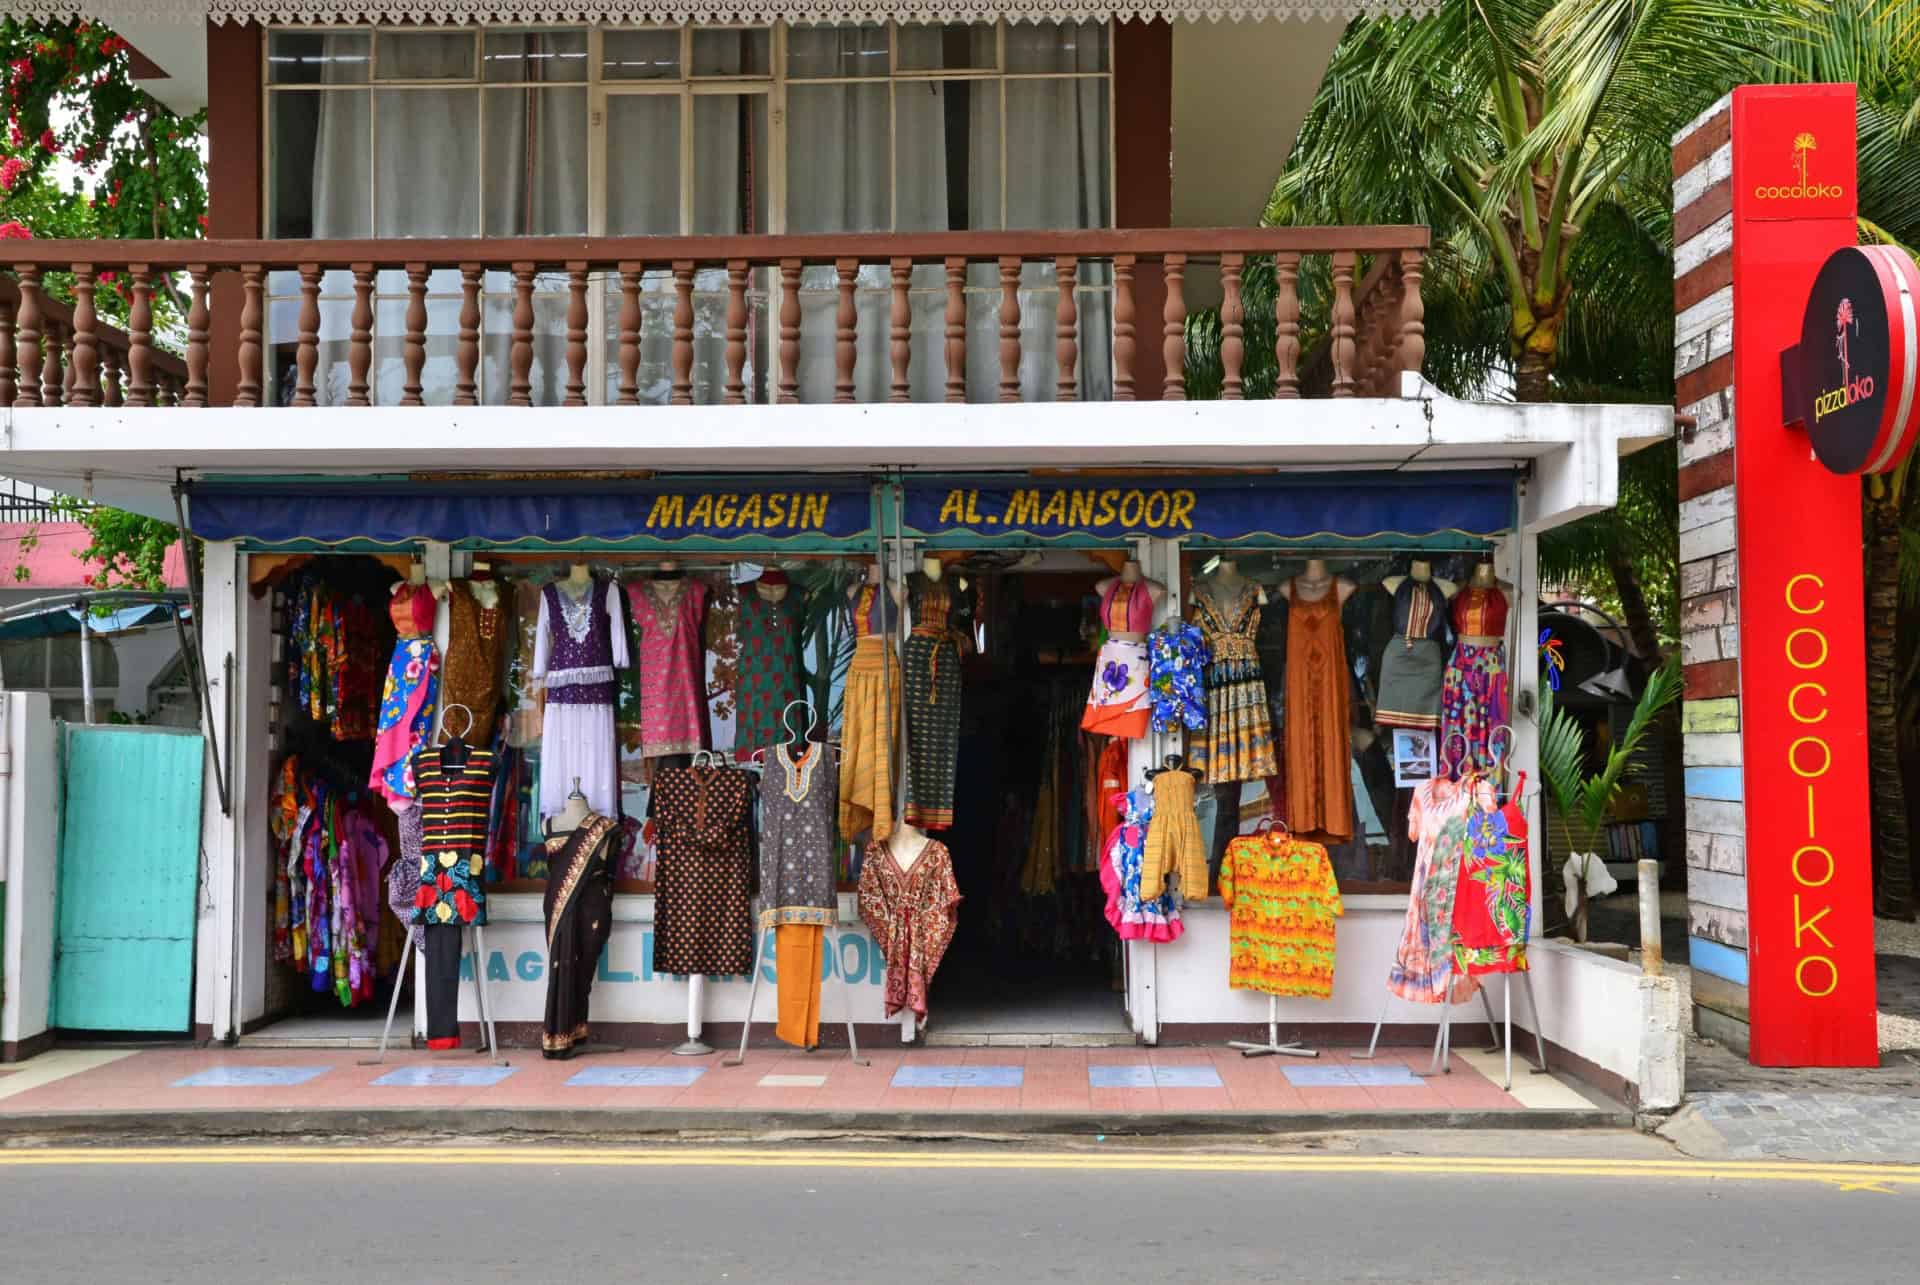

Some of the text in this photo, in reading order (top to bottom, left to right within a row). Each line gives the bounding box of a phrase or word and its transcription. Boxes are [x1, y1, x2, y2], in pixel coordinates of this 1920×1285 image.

[1755, 182, 1843, 199] cocoloko
[1815, 374, 1874, 424] pizzaloko
[645, 494, 829, 529] MAGASIN
